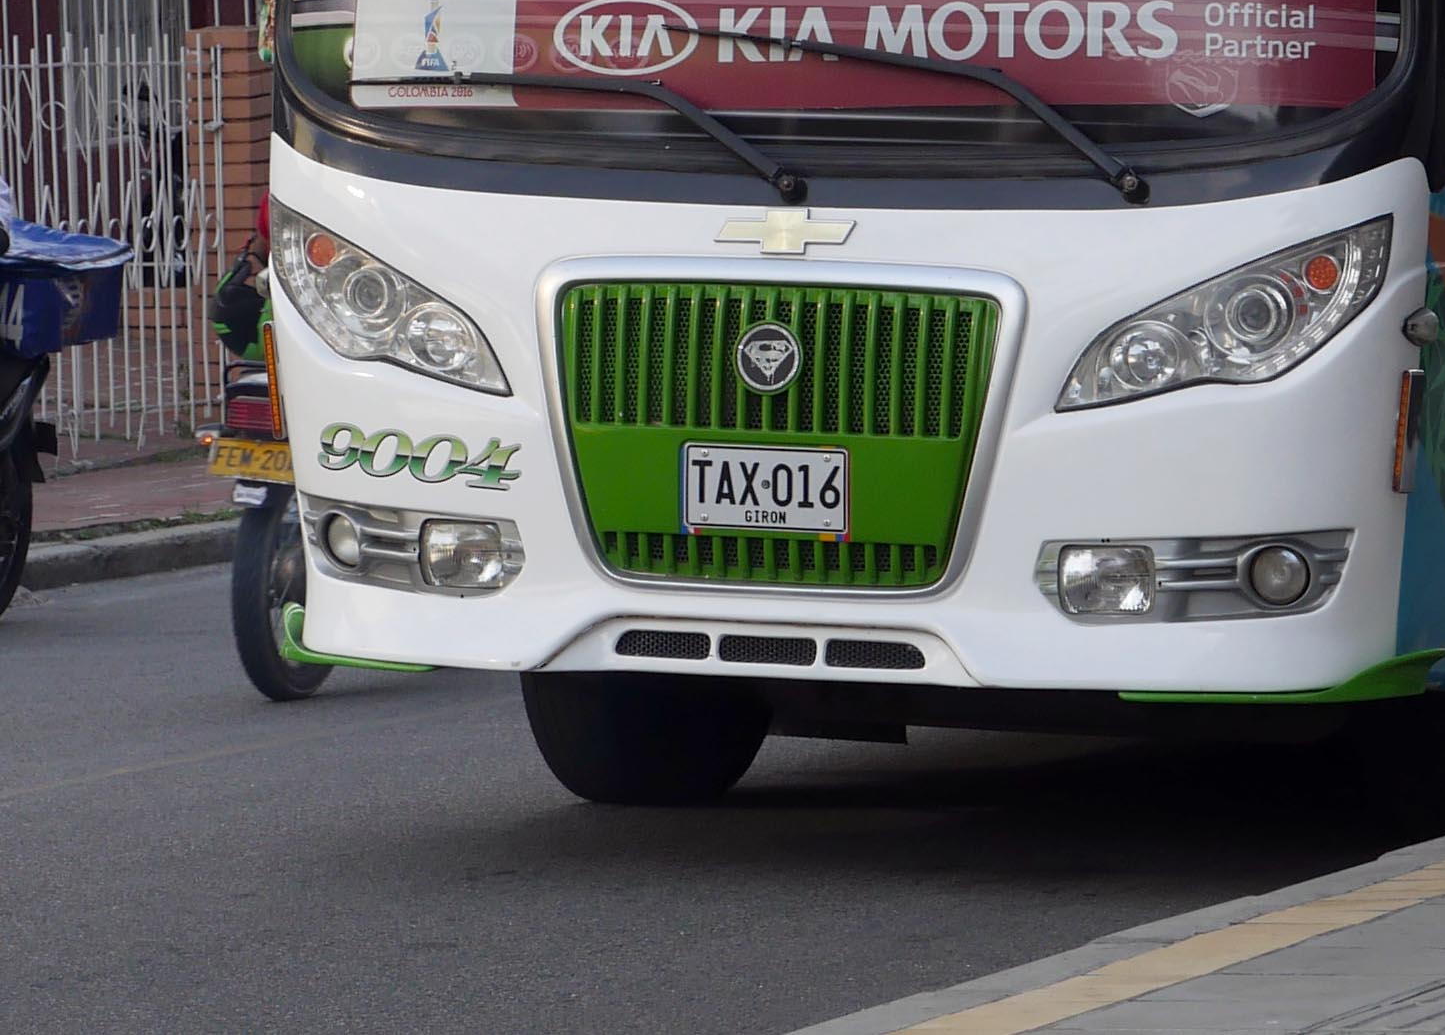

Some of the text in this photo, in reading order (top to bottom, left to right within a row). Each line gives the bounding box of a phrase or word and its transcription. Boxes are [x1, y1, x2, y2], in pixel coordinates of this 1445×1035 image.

[1204, 2, 1315, 29] Official
[578, 14, 675, 57] KIA
[717, 0, 1177, 63] KIA MOTORS
[1204, 32, 1317, 59] Partner
[421, 57, 440, 67] FIFA
[387, 85, 474, 99] COLOMBIA 2016
[316, 421, 523, 492] 9004
[744, 510, 787, 525] GIRON
